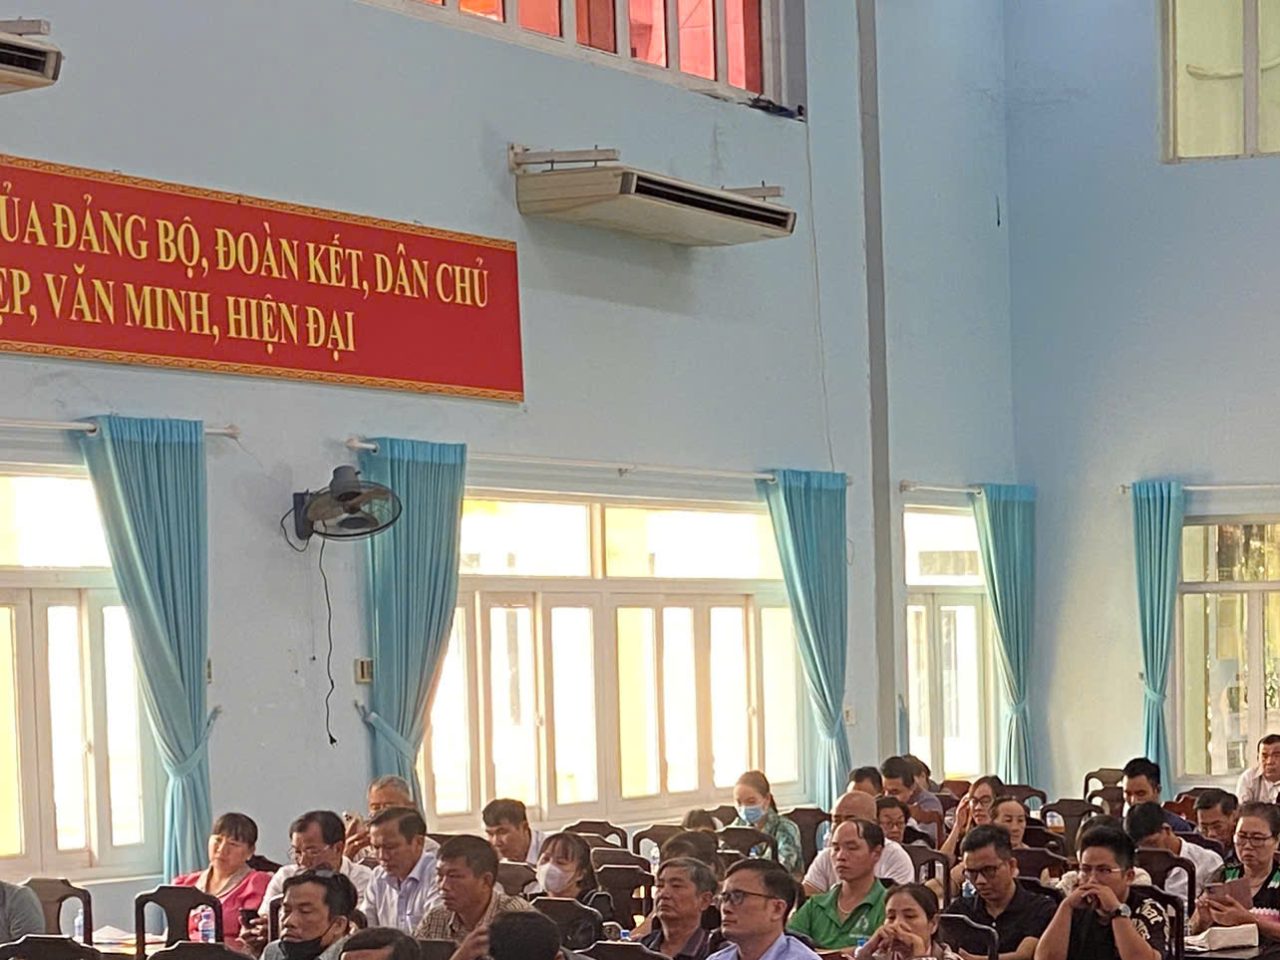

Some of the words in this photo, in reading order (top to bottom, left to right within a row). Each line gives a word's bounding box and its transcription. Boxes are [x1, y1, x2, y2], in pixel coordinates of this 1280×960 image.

[53, 194, 148, 260] ĐẢNG
[157, 216, 209, 279] BỘ,
[215, 222, 299, 281] ĐOÀN
[307, 233, 369, 298] KẾT,
[375, 243, 429, 299] DÂN
[436, 256, 489, 308] CHỦ
[44, 263, 115, 325] VĂN
[123, 282, 220, 345] MINH,
[227, 294, 298, 355] HIỆN
[306, 305, 356, 361] ĐẠI
